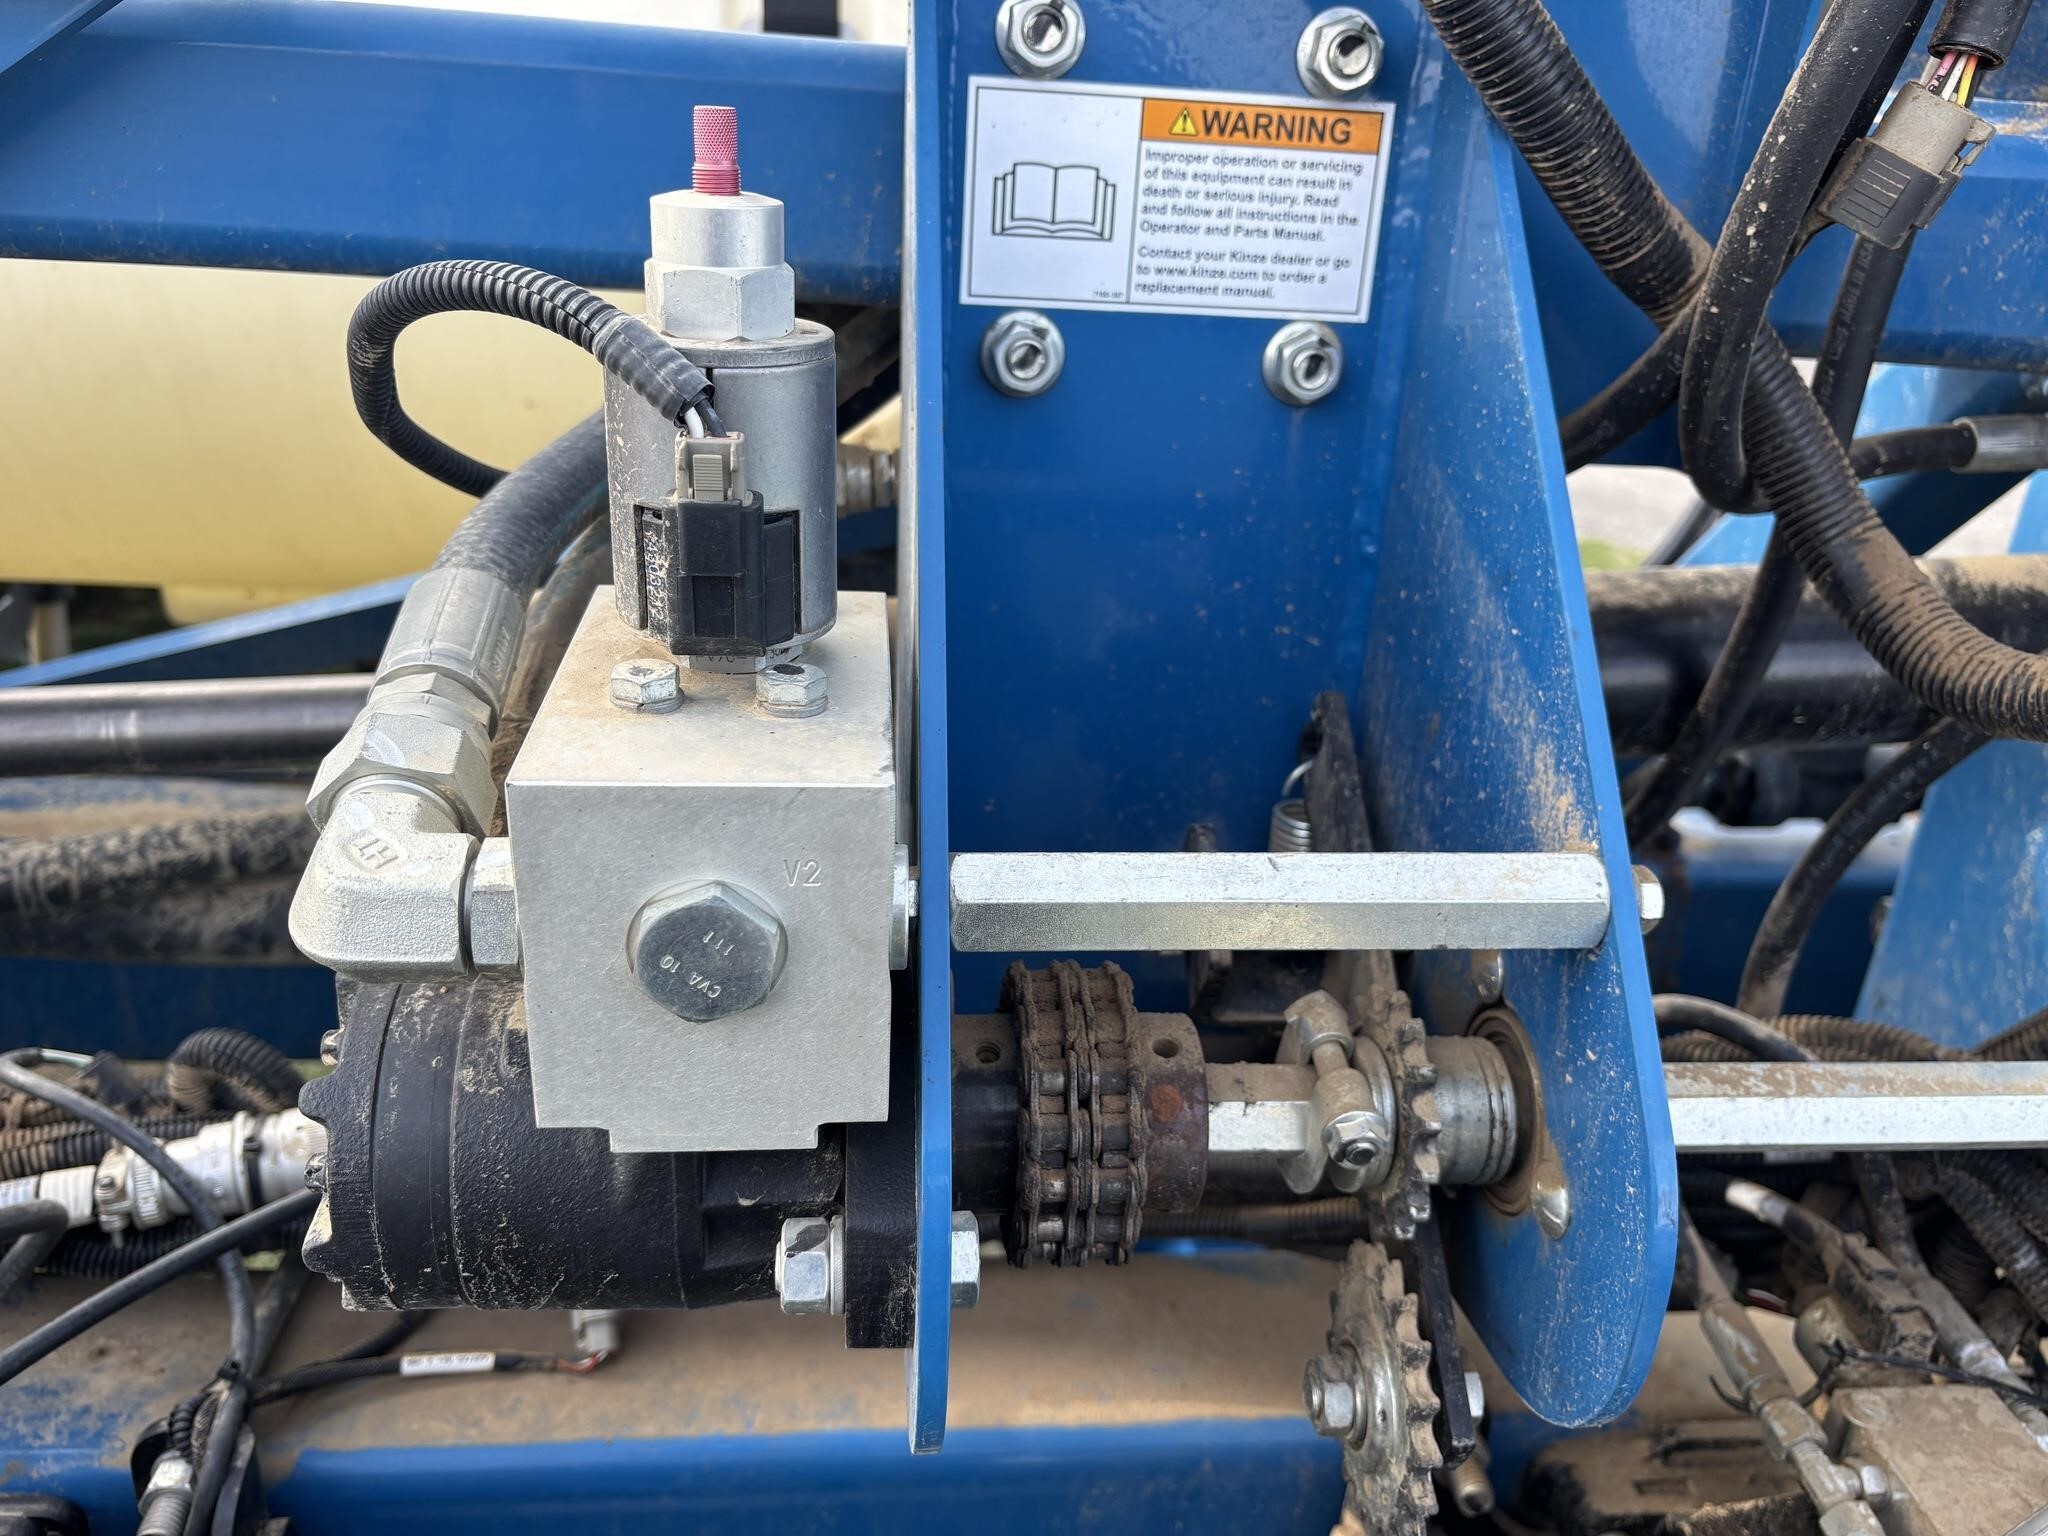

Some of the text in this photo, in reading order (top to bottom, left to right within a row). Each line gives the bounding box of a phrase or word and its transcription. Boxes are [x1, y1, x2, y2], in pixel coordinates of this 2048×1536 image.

[1203, 109, 1351, 144] WARNING
[1145, 148, 1364, 176] Improper operation or servicing
[1144, 166, 1352, 191] of this equipment can result in
[1143, 183, 1339, 208] death or serious injury. Read
[1141, 202, 1359, 226] and follow all instructions in the
[1140, 220, 1326, 241] Operator and Parts Manual.
[1138, 245, 1353, 270] Contact your Kinze dealer or go
[1136, 263, 1328, 284] to www.kinze.com to order a
[1134, 279, 1219, 296] replacement
[1220, 285, 1276, 299] manual.
[783, 858, 822, 887] V2
[688, 971, 722, 998] CVA
